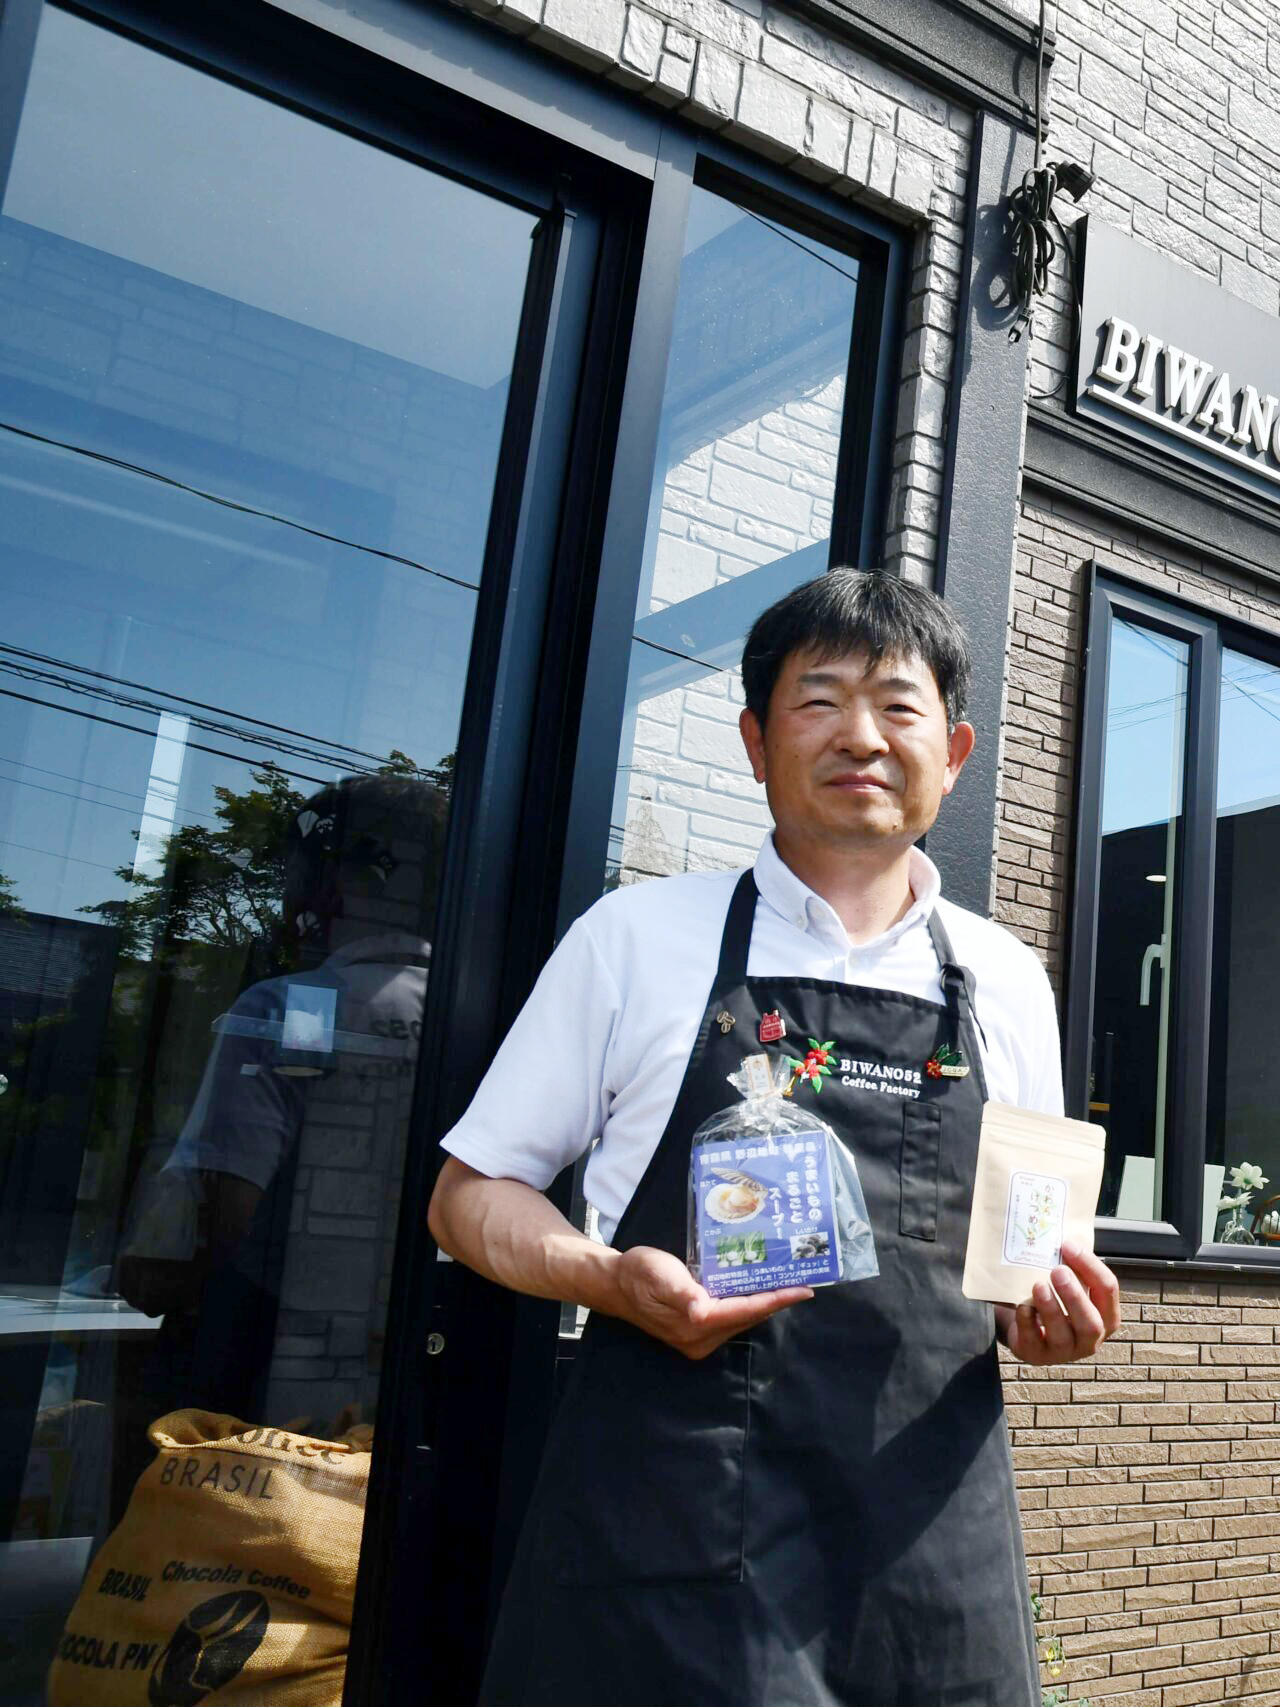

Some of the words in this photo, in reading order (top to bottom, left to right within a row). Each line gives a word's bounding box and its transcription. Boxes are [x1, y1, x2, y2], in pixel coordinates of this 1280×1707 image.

[839, 1058, 922, 1084] BIWANO52
[841, 1075, 878, 1090] Coffee
[880, 1081, 920, 1099] Factory
[804, 1155, 823, 1222] うまいもの
[159, 1456, 274, 1500] BRASIL
[98, 1568, 151, 1602] BRASIL
[161, 1559, 244, 1584] Chocola
[246, 1570, 312, 1599] Coffee
